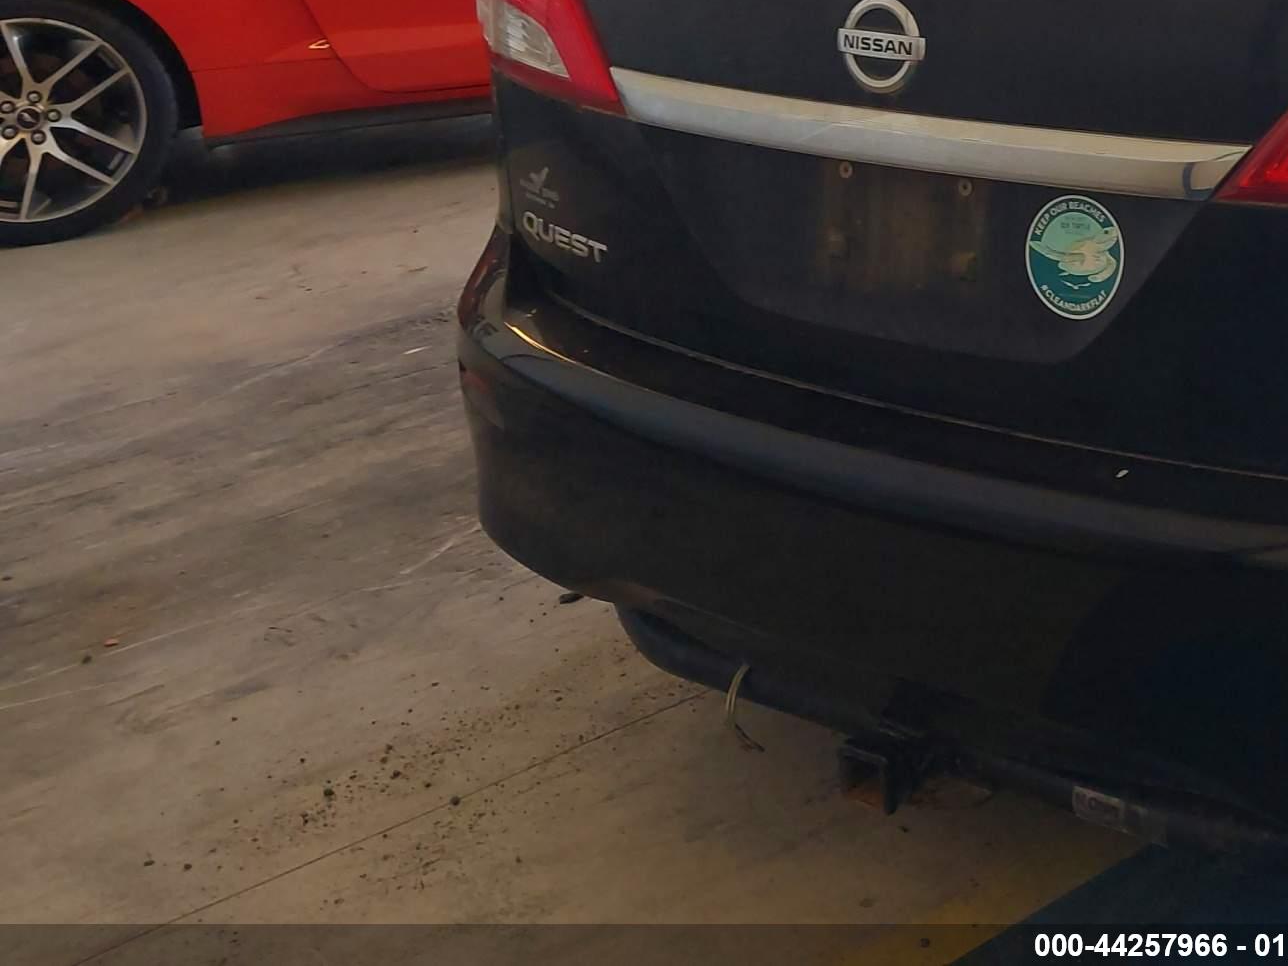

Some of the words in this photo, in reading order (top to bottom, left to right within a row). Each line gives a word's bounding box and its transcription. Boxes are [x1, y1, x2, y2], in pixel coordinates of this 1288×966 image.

[843, 33, 914, 56] NISSAN
[1034, 212, 1050, 236] KEEP
[1050, 202, 1068, 216] OUR
[1068, 201, 1106, 223] BEACHES
[522, 210, 608, 263] QUEST
